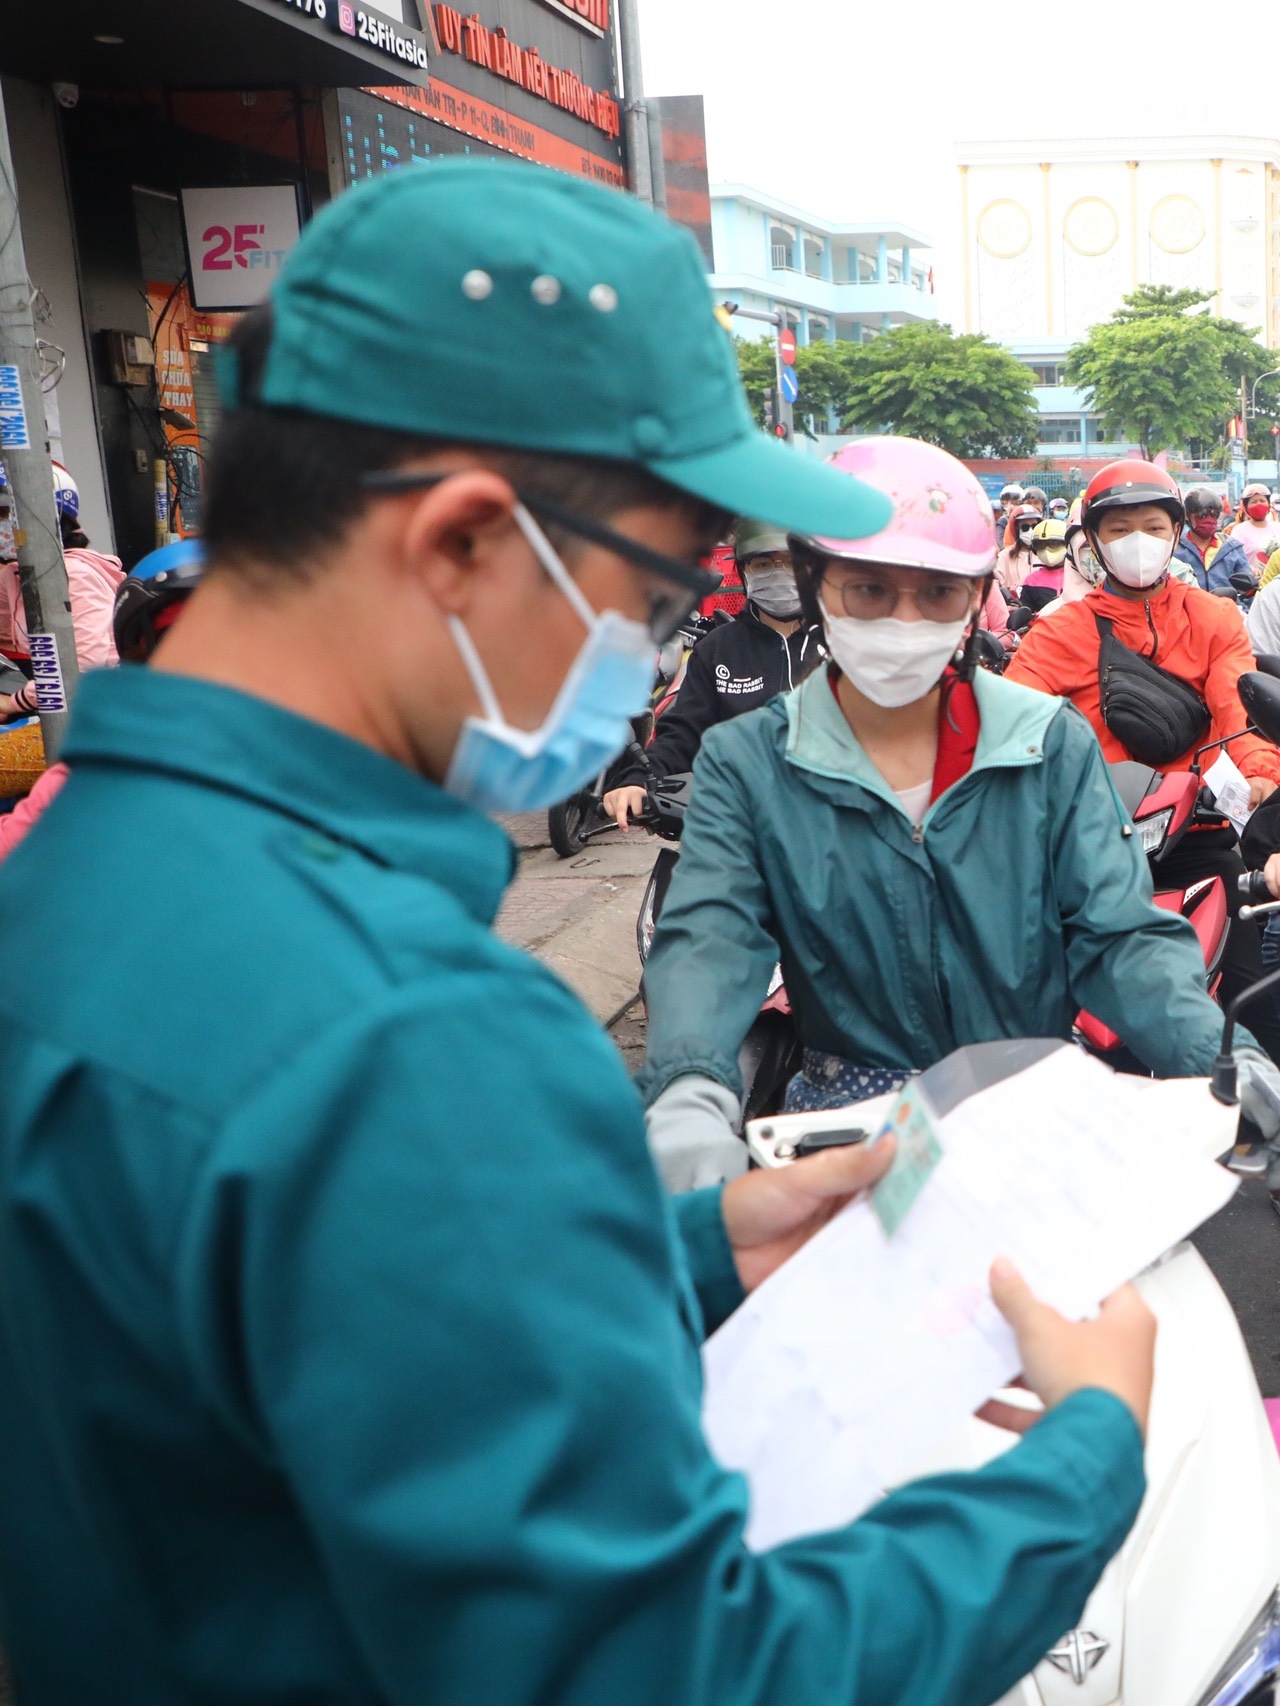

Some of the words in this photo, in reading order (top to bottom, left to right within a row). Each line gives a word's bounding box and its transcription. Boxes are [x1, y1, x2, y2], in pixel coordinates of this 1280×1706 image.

[436, 3, 462, 54] UY
[357, 11, 428, 69] 25Fitasia
[164, 391, 193, 407] THAY
[715, 679, 728, 688] THE
[743, 676, 763, 688] RABBIT
[742, 683, 765, 694] RABBIT
